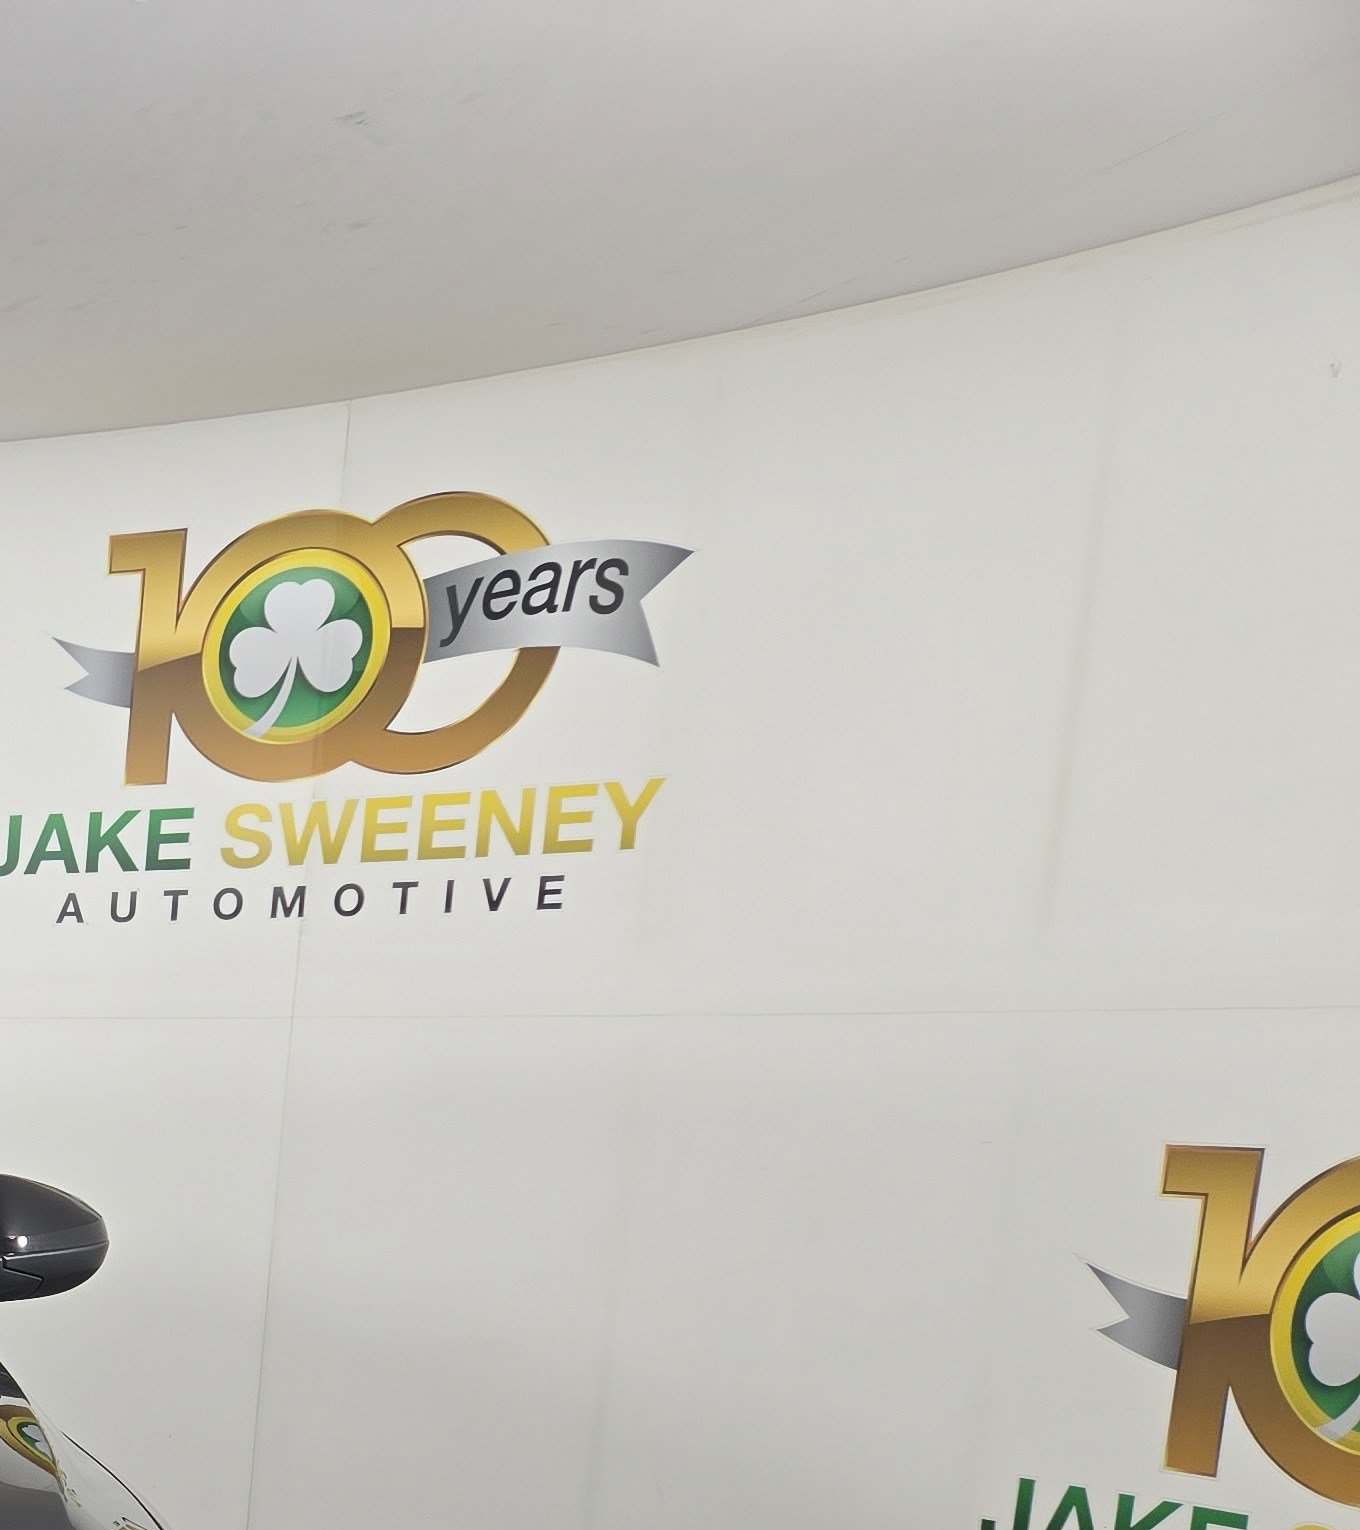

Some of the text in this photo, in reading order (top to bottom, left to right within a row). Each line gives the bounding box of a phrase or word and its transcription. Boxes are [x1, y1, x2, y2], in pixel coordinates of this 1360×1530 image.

[438, 556, 629, 648] years
[220, 777, 667, 871] SWEENEY
[55, 874, 566, 925] AUTOMOTIVE
